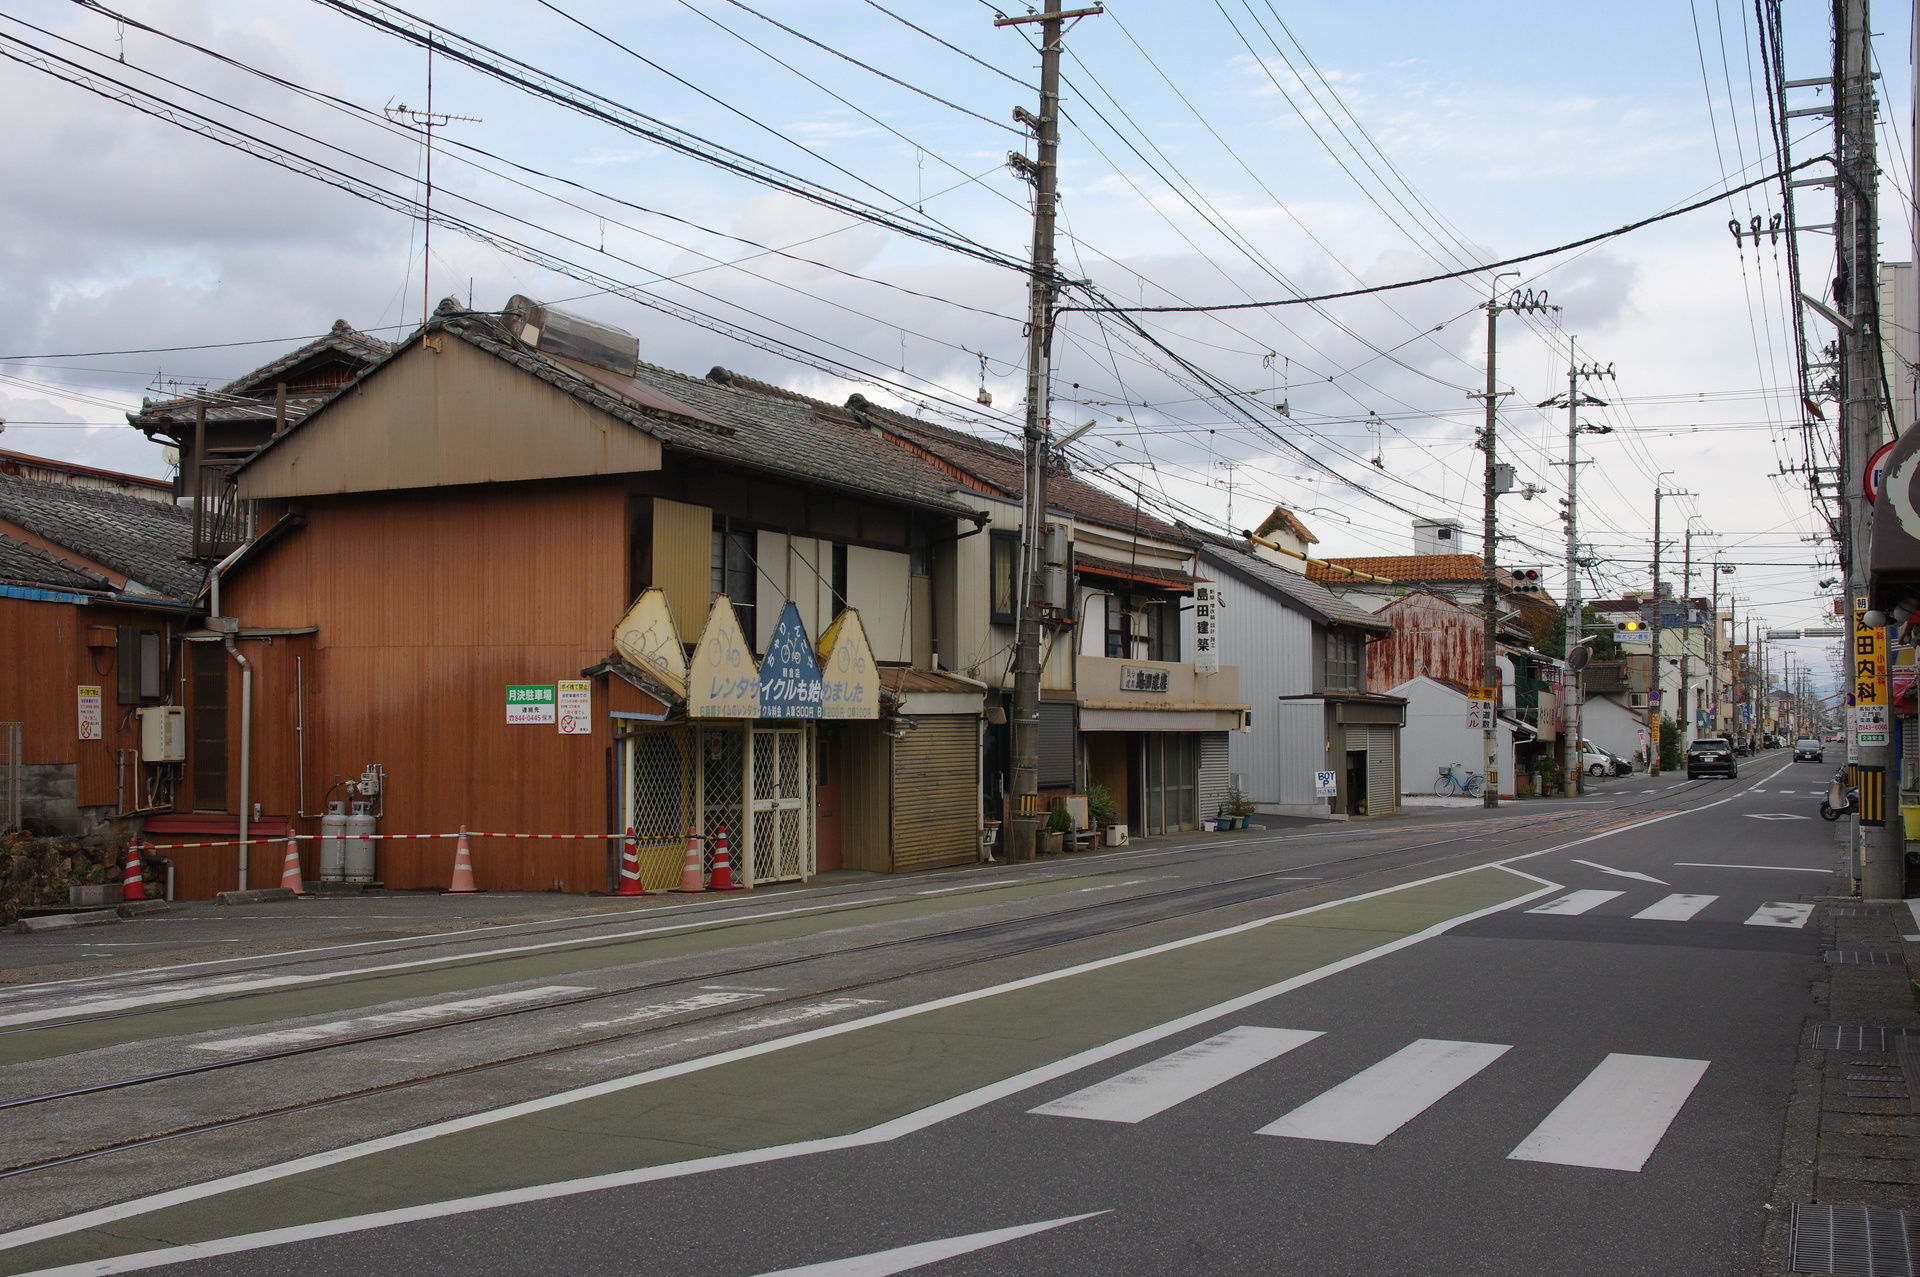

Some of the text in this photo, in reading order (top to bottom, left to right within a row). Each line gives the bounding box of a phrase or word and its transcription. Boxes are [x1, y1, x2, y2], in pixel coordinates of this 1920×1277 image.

[1197, 587, 1209, 651] 島田建築
[560, 683, 588, 691] ポイ捨て禁止
[709, 677, 864, 703] レンタサイクルも始めました
[508, 689, 553, 701] 月決駐車場
[1470, 689, 1493, 699] 注意
[1469, 702, 1480, 728] スベル
[1482, 702, 1491, 728] 軌道敷
[1318, 772, 1335, 780] BOY
[1323, 780, 1330, 788] P
